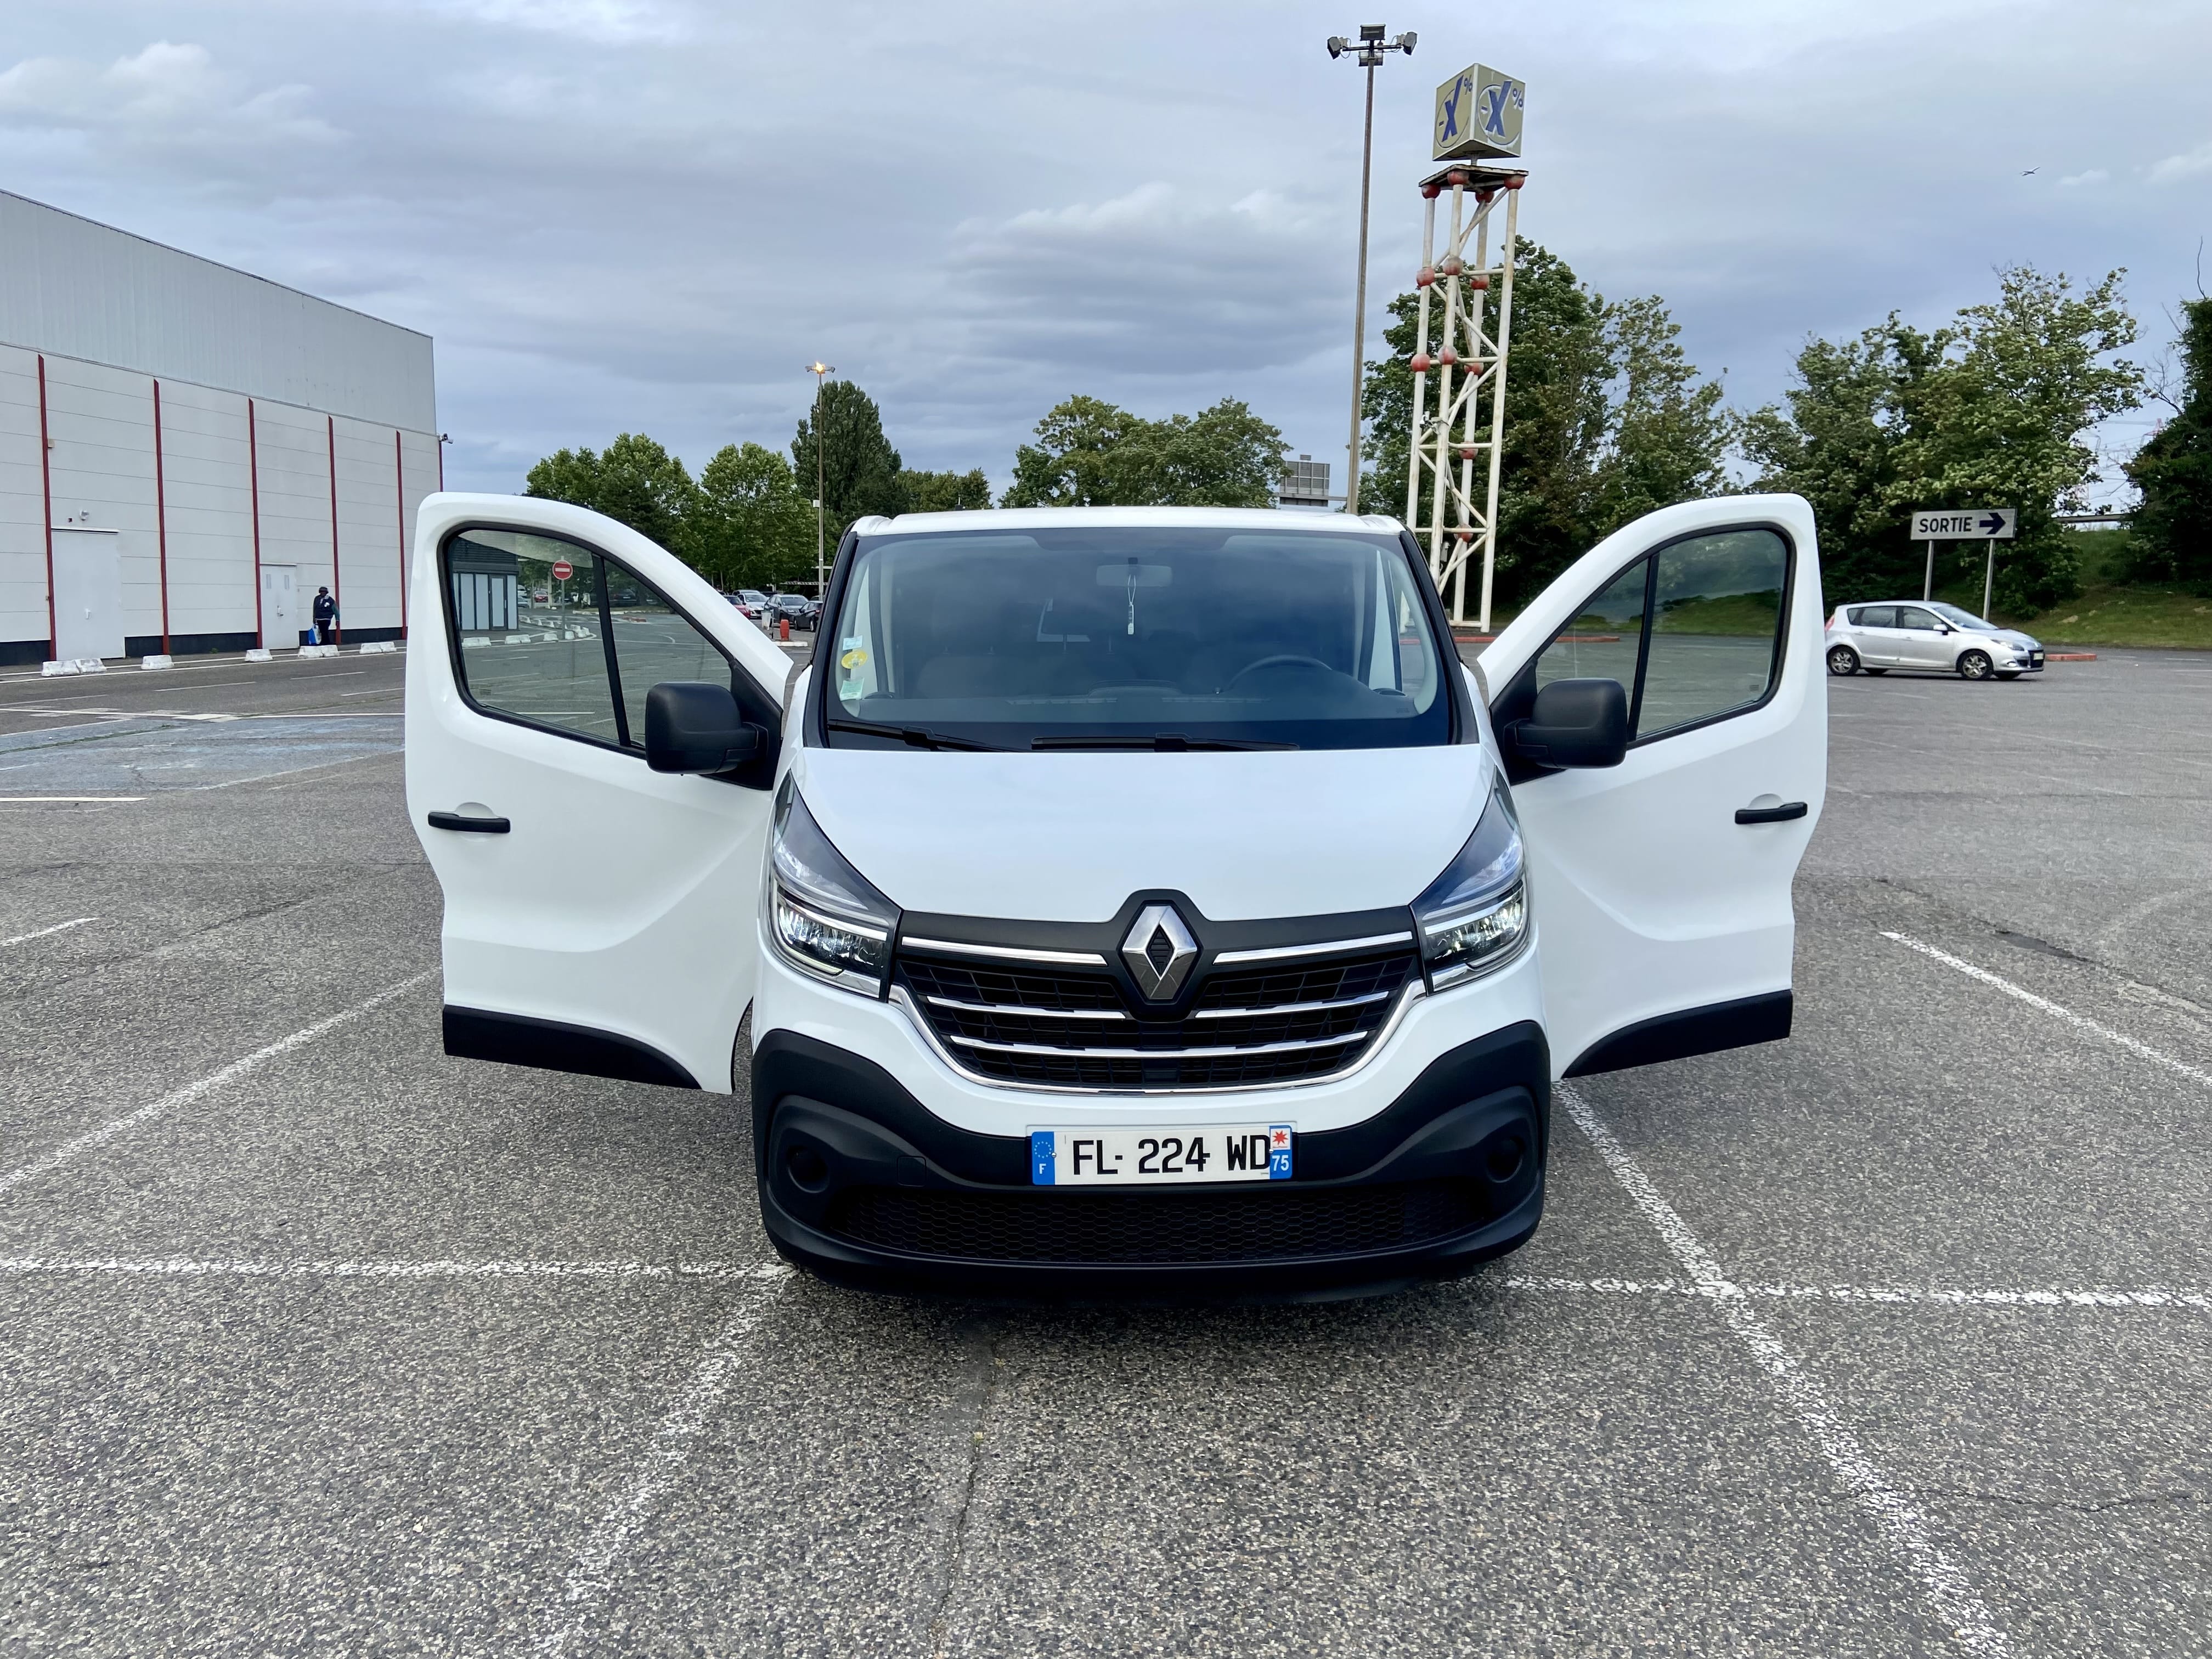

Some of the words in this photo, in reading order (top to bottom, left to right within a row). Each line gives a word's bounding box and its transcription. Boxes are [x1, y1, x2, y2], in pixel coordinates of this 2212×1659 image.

[1918, 516, 1973, 533] SORTIE
[1039, 1163, 1047, 1175] F
[1272, 1154, 1289, 1171] 75
